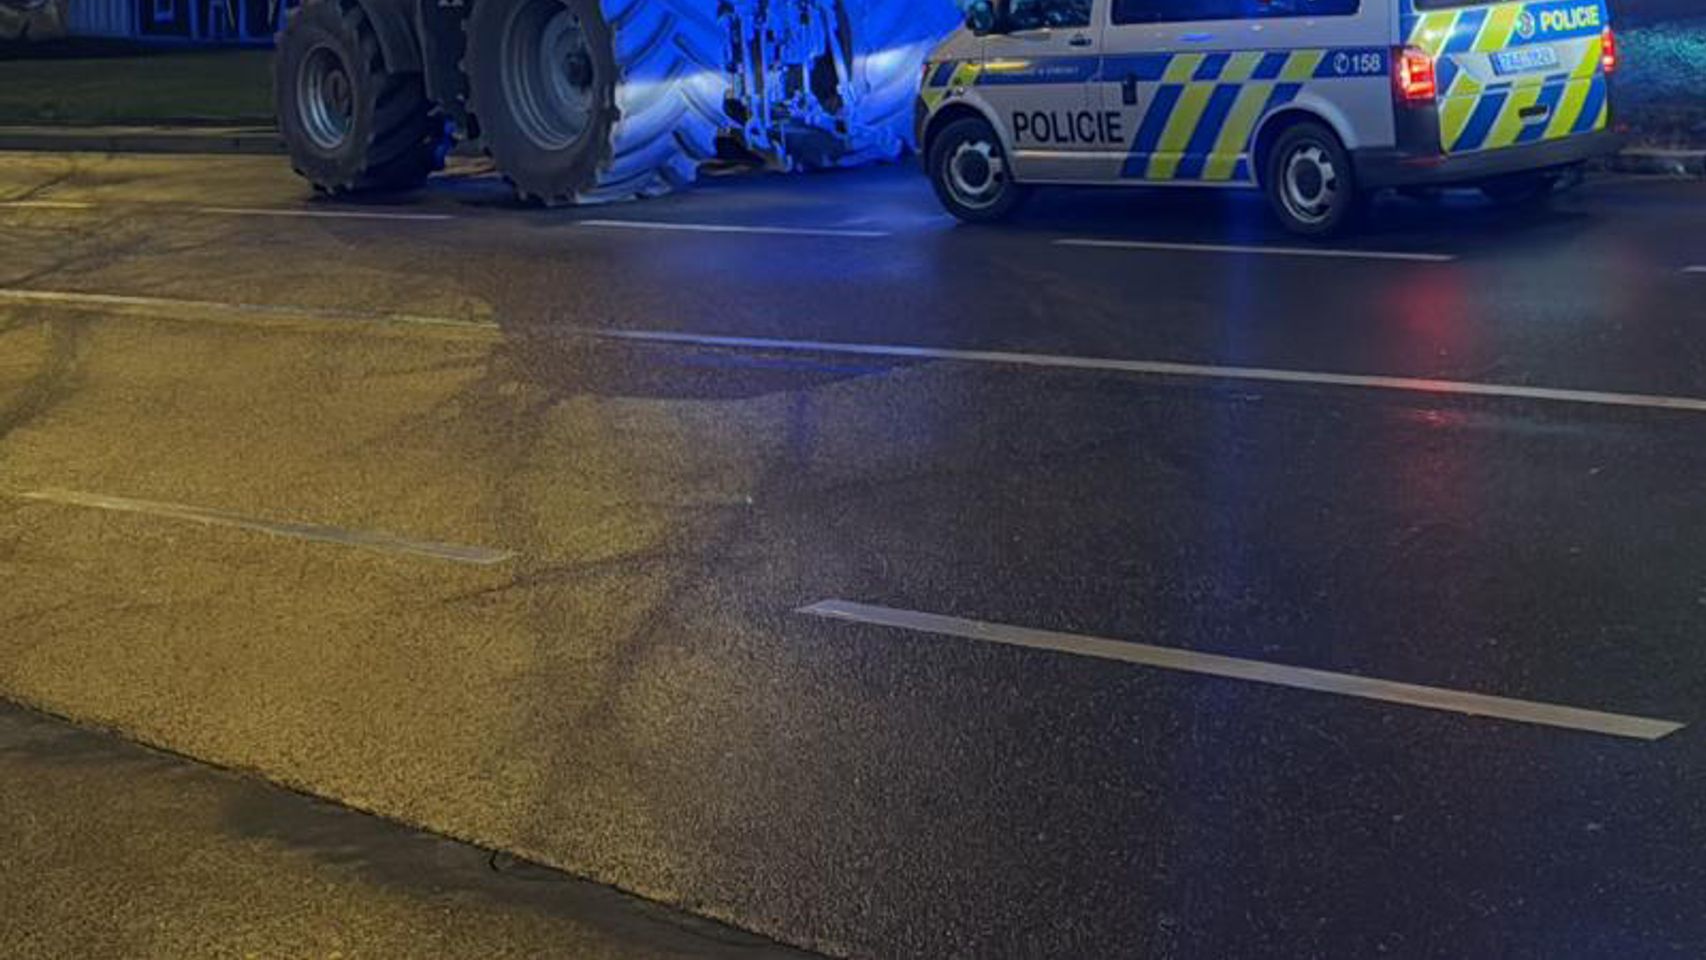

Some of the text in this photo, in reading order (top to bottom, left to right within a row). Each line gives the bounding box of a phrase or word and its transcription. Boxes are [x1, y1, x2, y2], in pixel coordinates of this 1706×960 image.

[1540, 4, 1600, 31] POLICIE
[1352, 54, 1382, 72] 158
[1012, 111, 1124, 144] POLICIE
